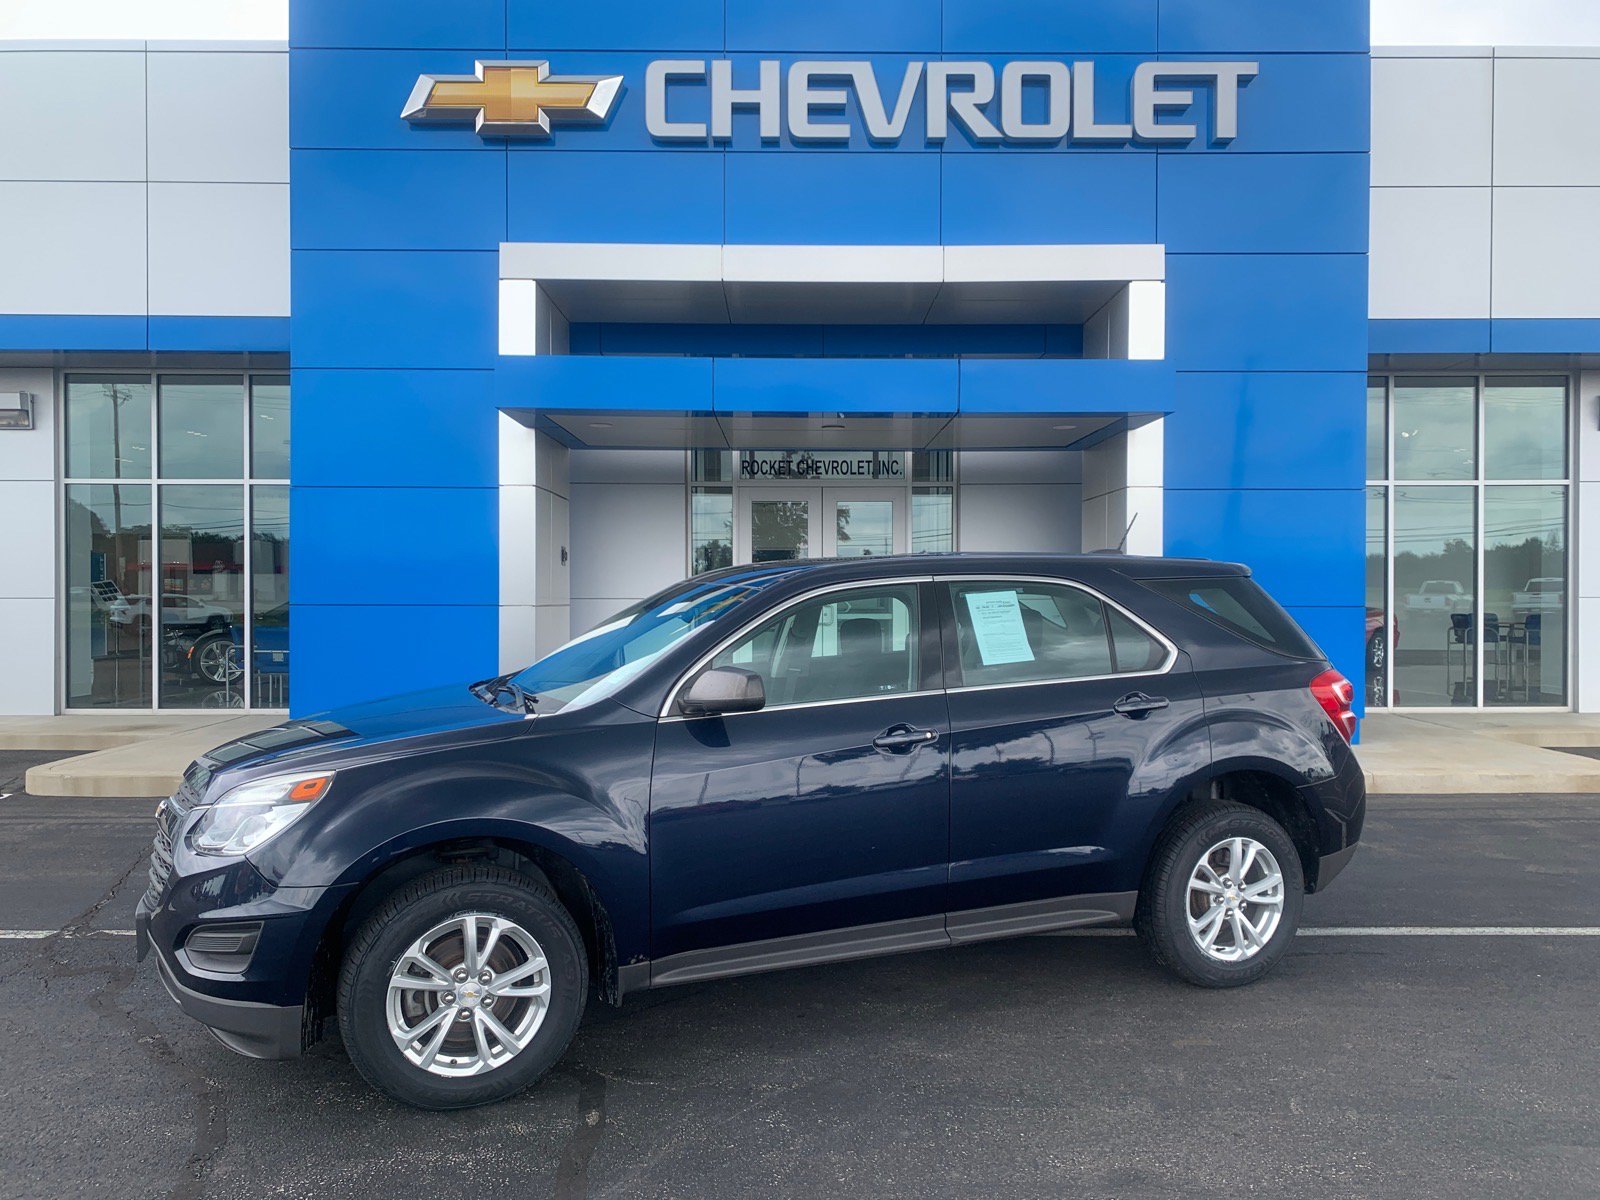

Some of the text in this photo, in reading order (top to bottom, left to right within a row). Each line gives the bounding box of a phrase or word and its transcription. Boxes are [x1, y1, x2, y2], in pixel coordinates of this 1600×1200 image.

[645, 60, 1259, 139] CHEVROLET
[742, 460, 793, 476] ROCKET
[879, 460, 902, 475] INC.
